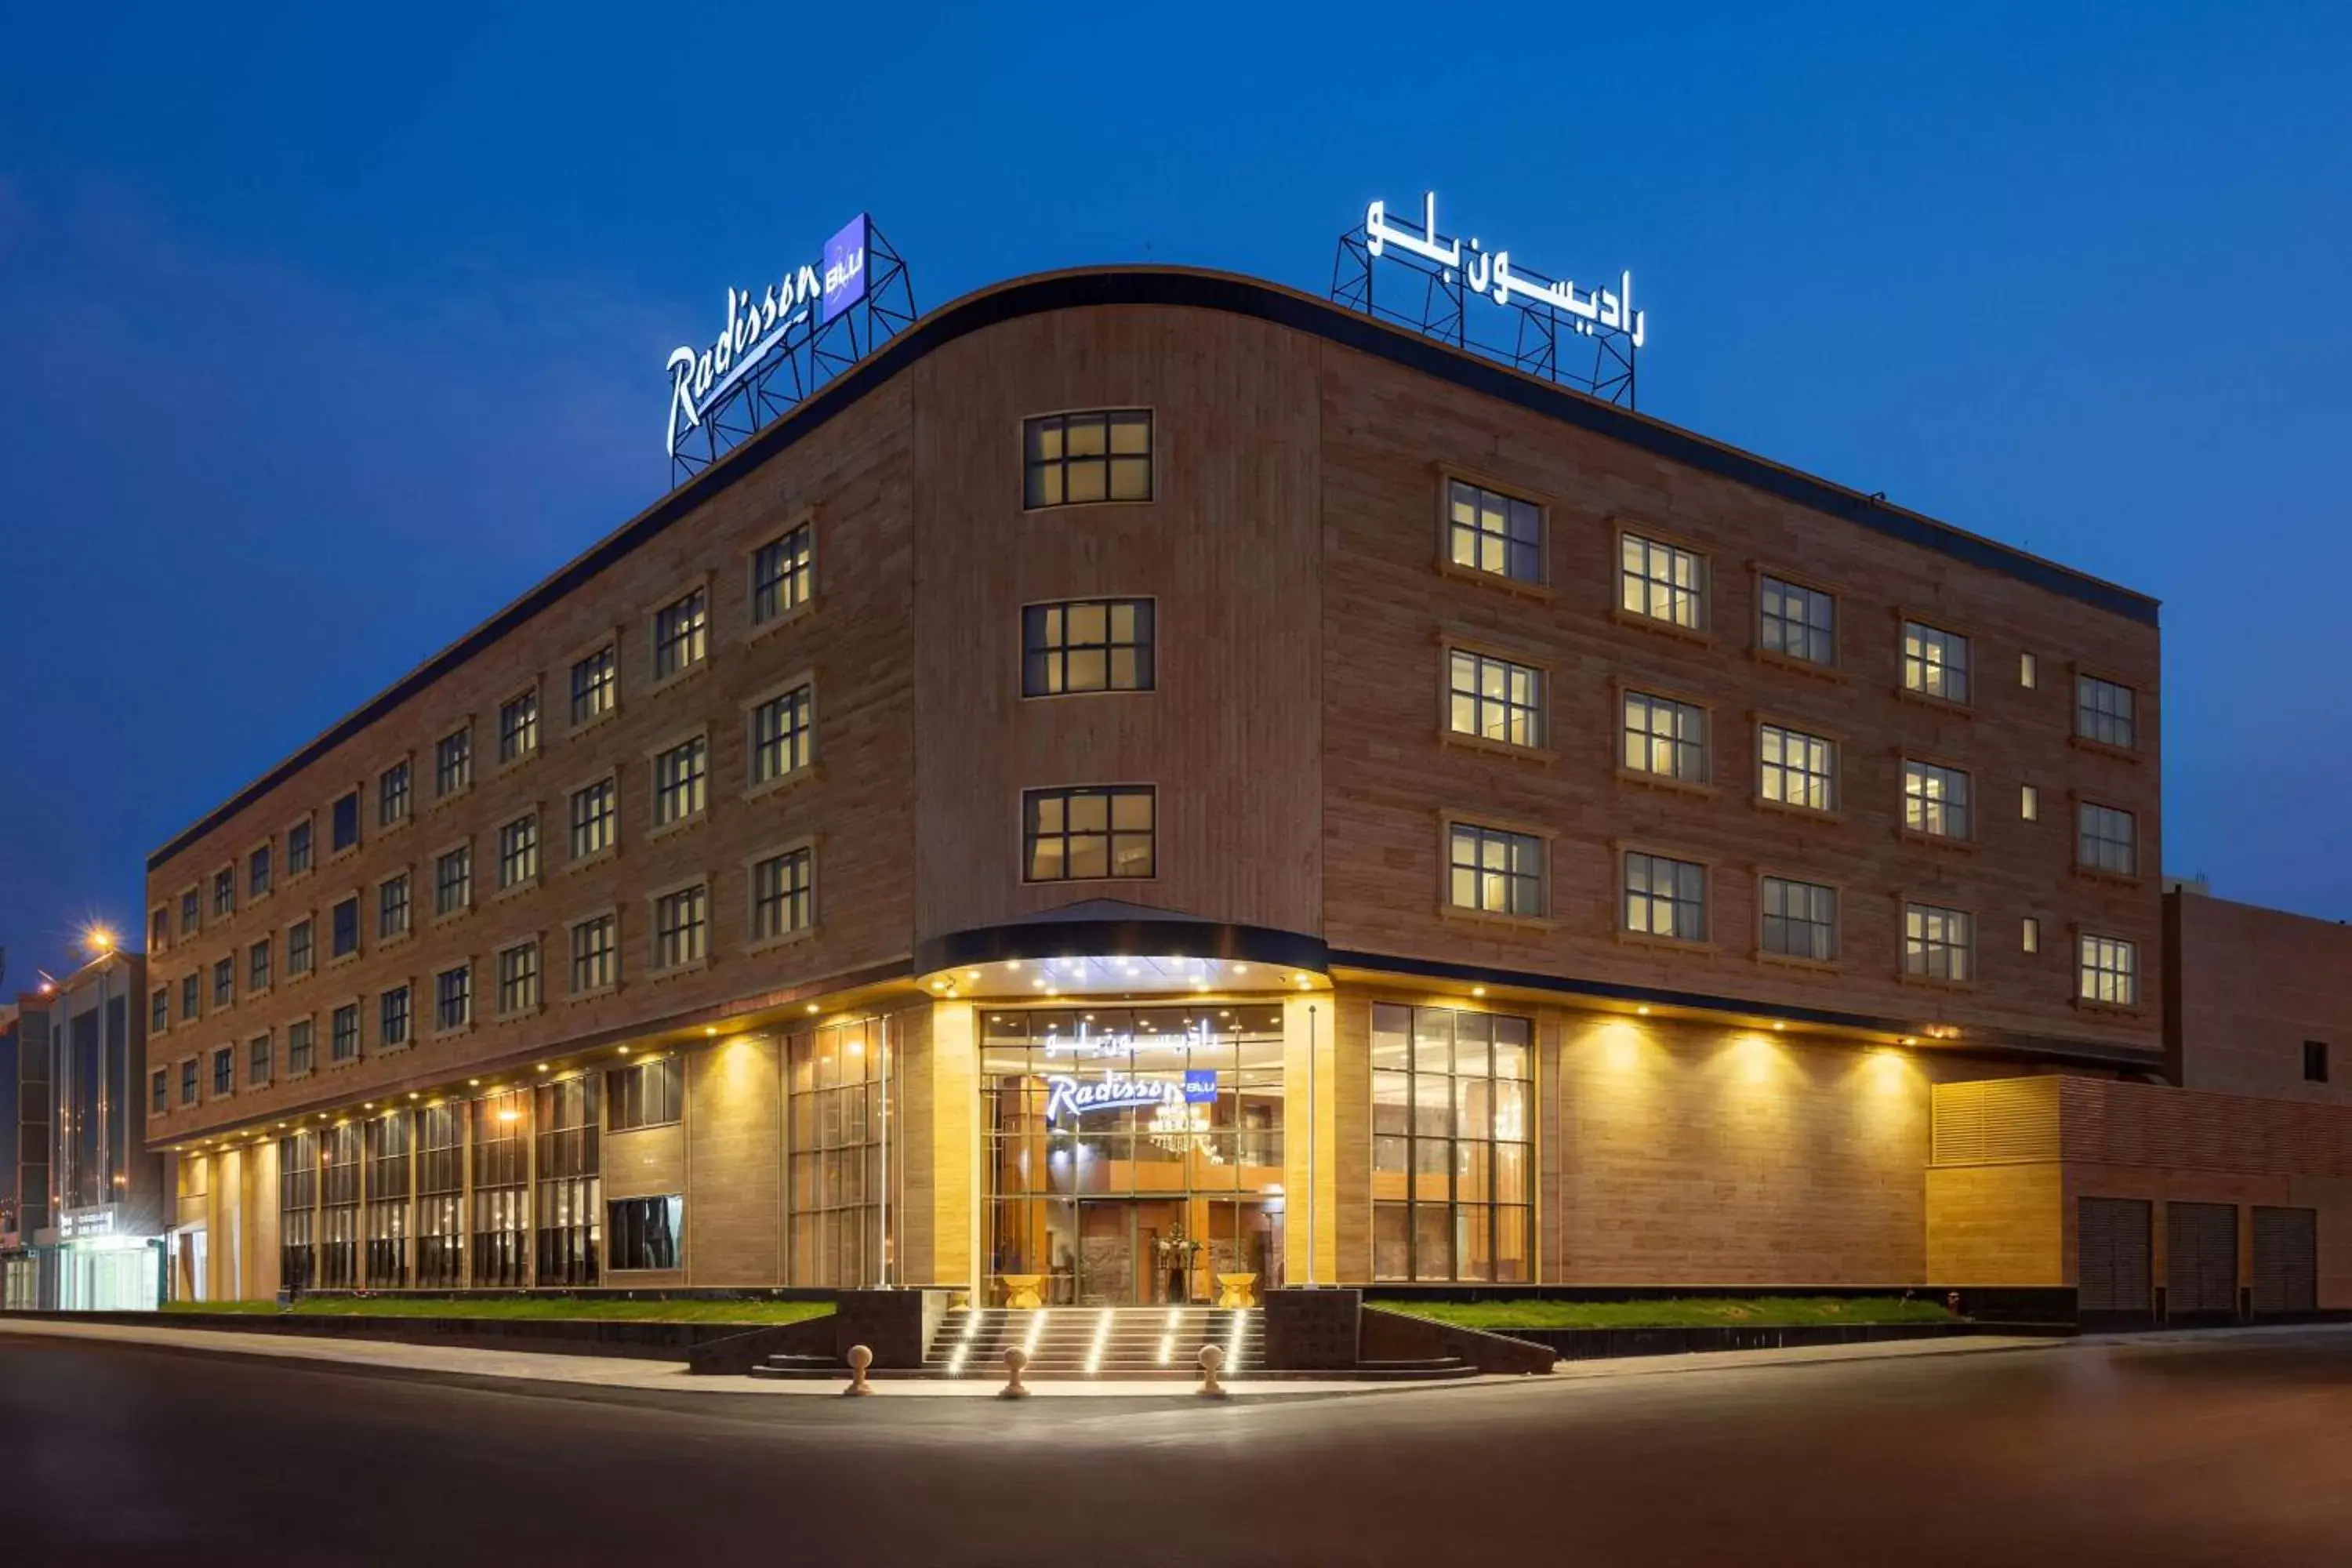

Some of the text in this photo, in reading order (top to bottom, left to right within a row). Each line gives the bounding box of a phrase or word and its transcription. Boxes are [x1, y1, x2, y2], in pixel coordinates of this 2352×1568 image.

[1366, 191, 1644, 347] راديسون بلو
[666, 246, 863, 458] Radisson BLU
[1046, 1068, 1215, 1121] Radisson BLU
